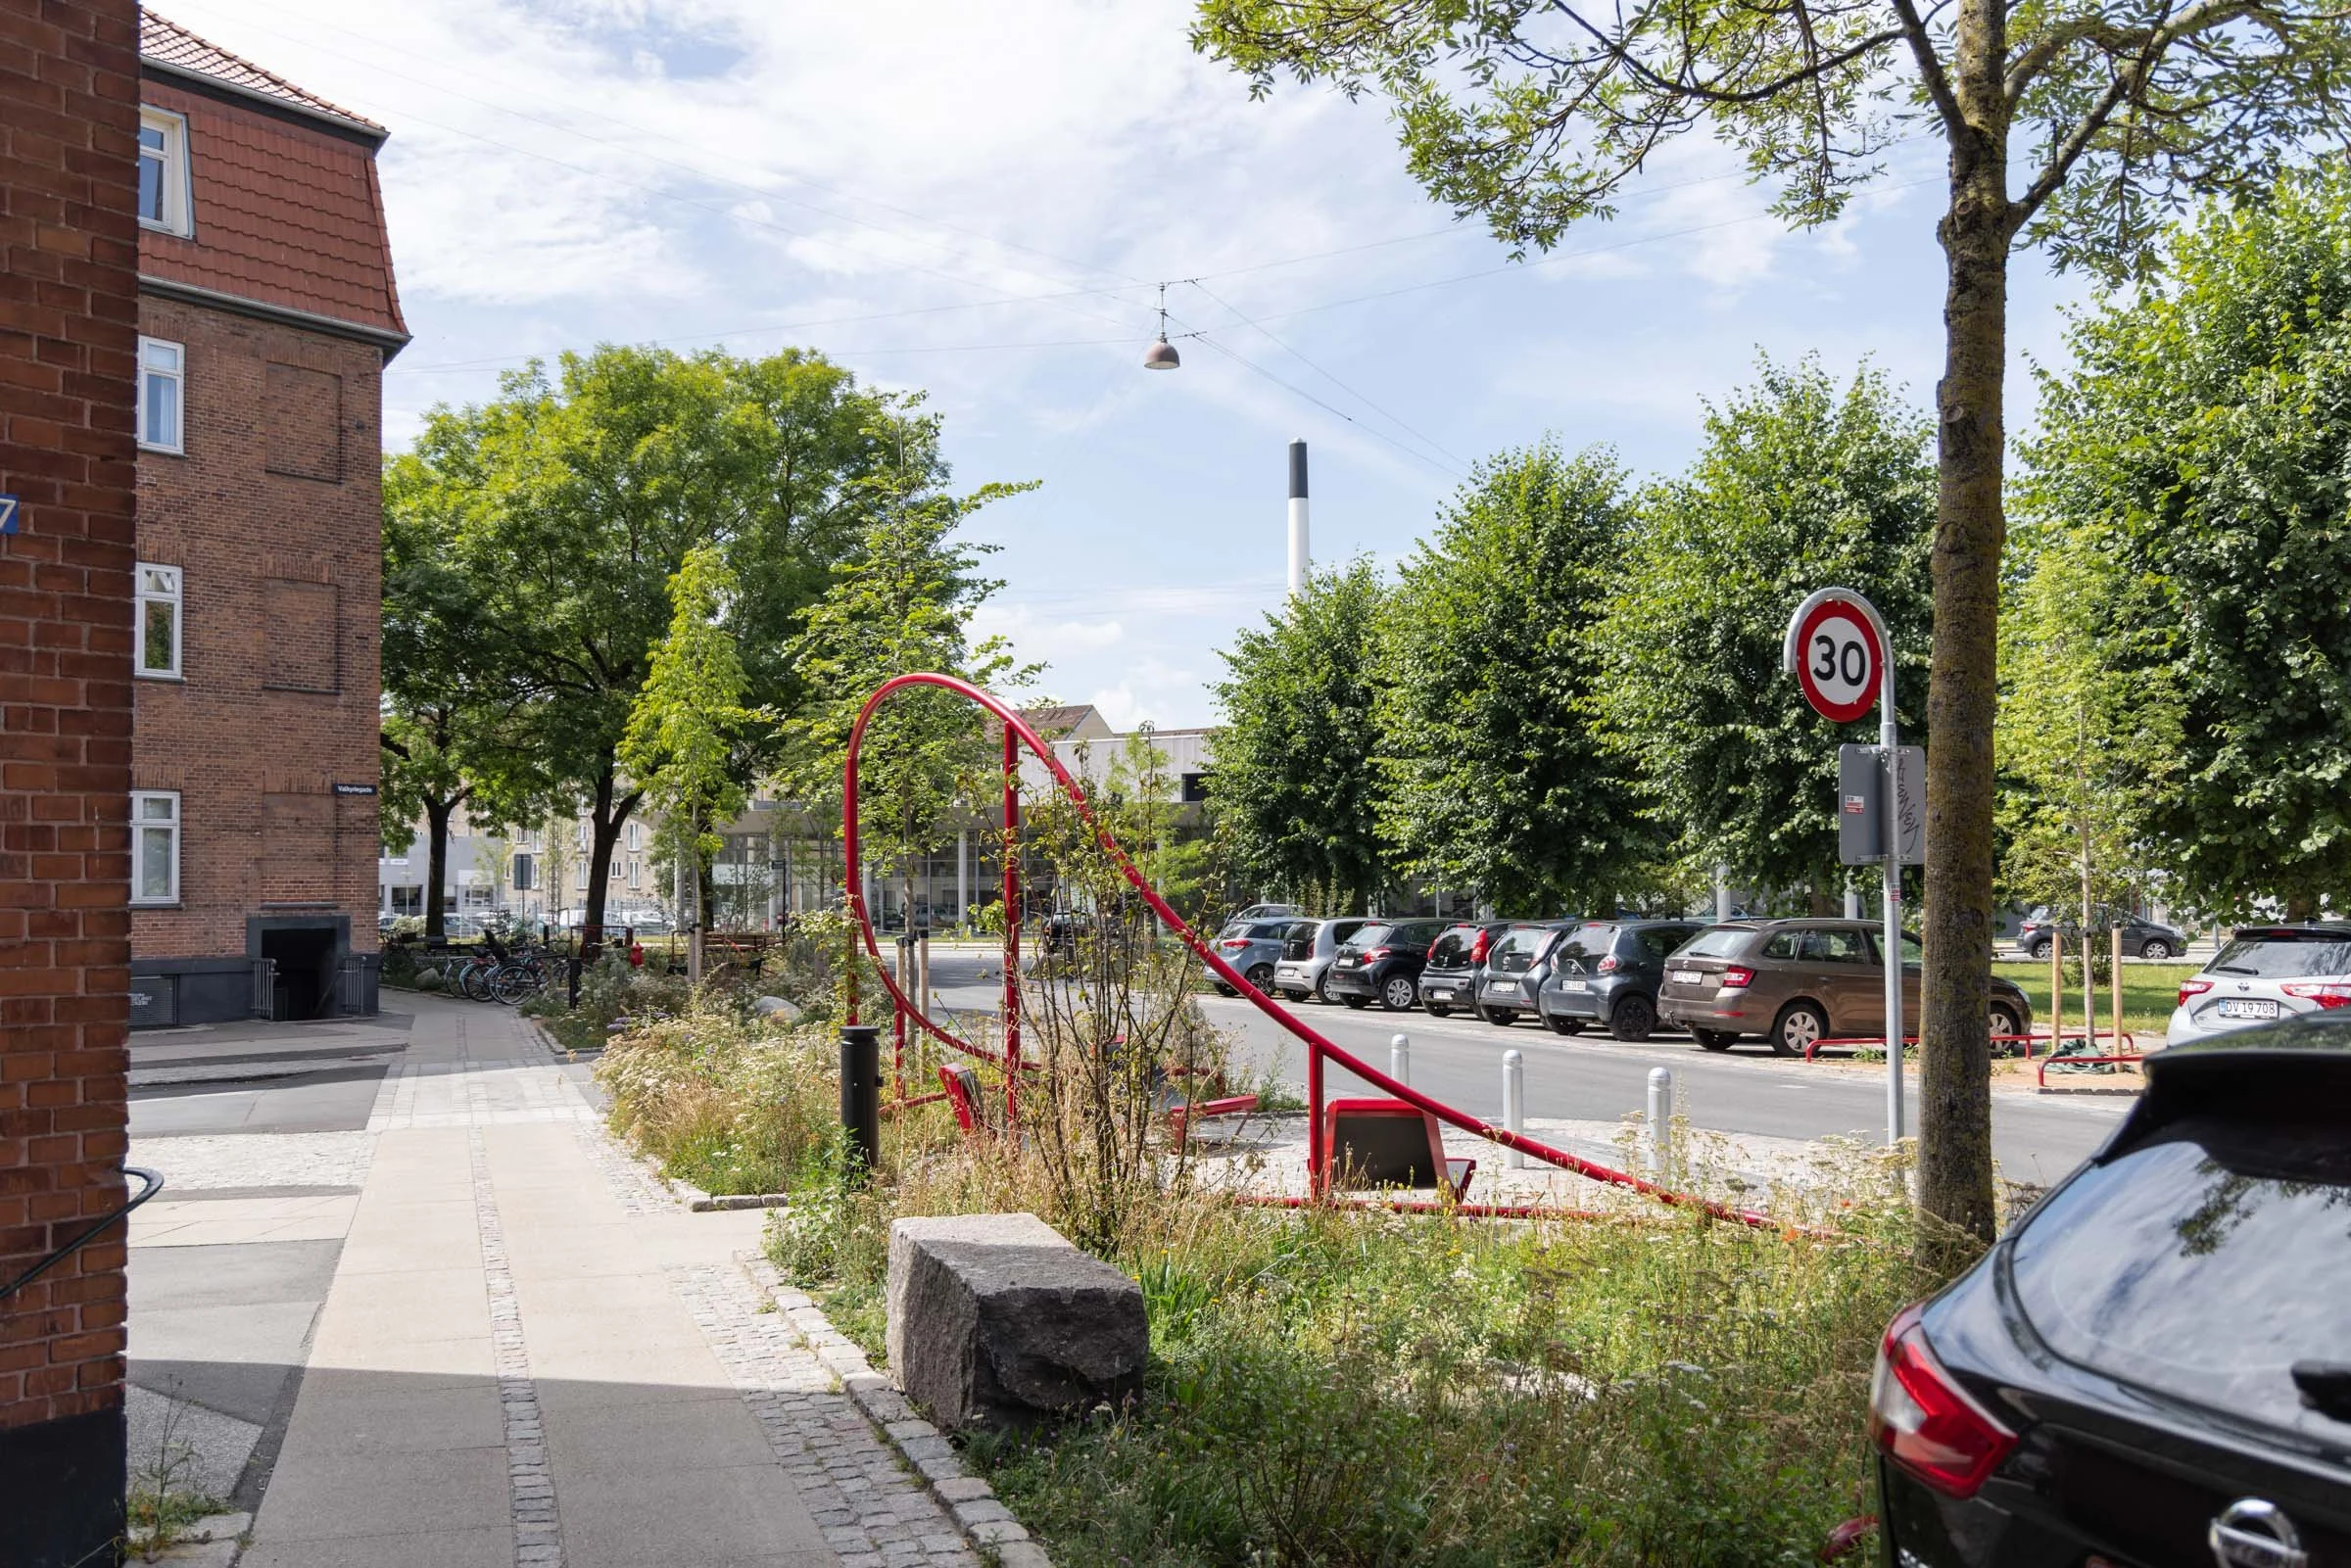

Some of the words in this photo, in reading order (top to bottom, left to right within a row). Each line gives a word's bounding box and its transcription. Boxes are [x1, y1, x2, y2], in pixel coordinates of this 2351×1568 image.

[1813, 635, 1866, 687] 30
[2226, 1001, 2239, 1013] DV
[2242, 1002, 2253, 1014] 19
[2256, 1002, 2275, 1014] 708
